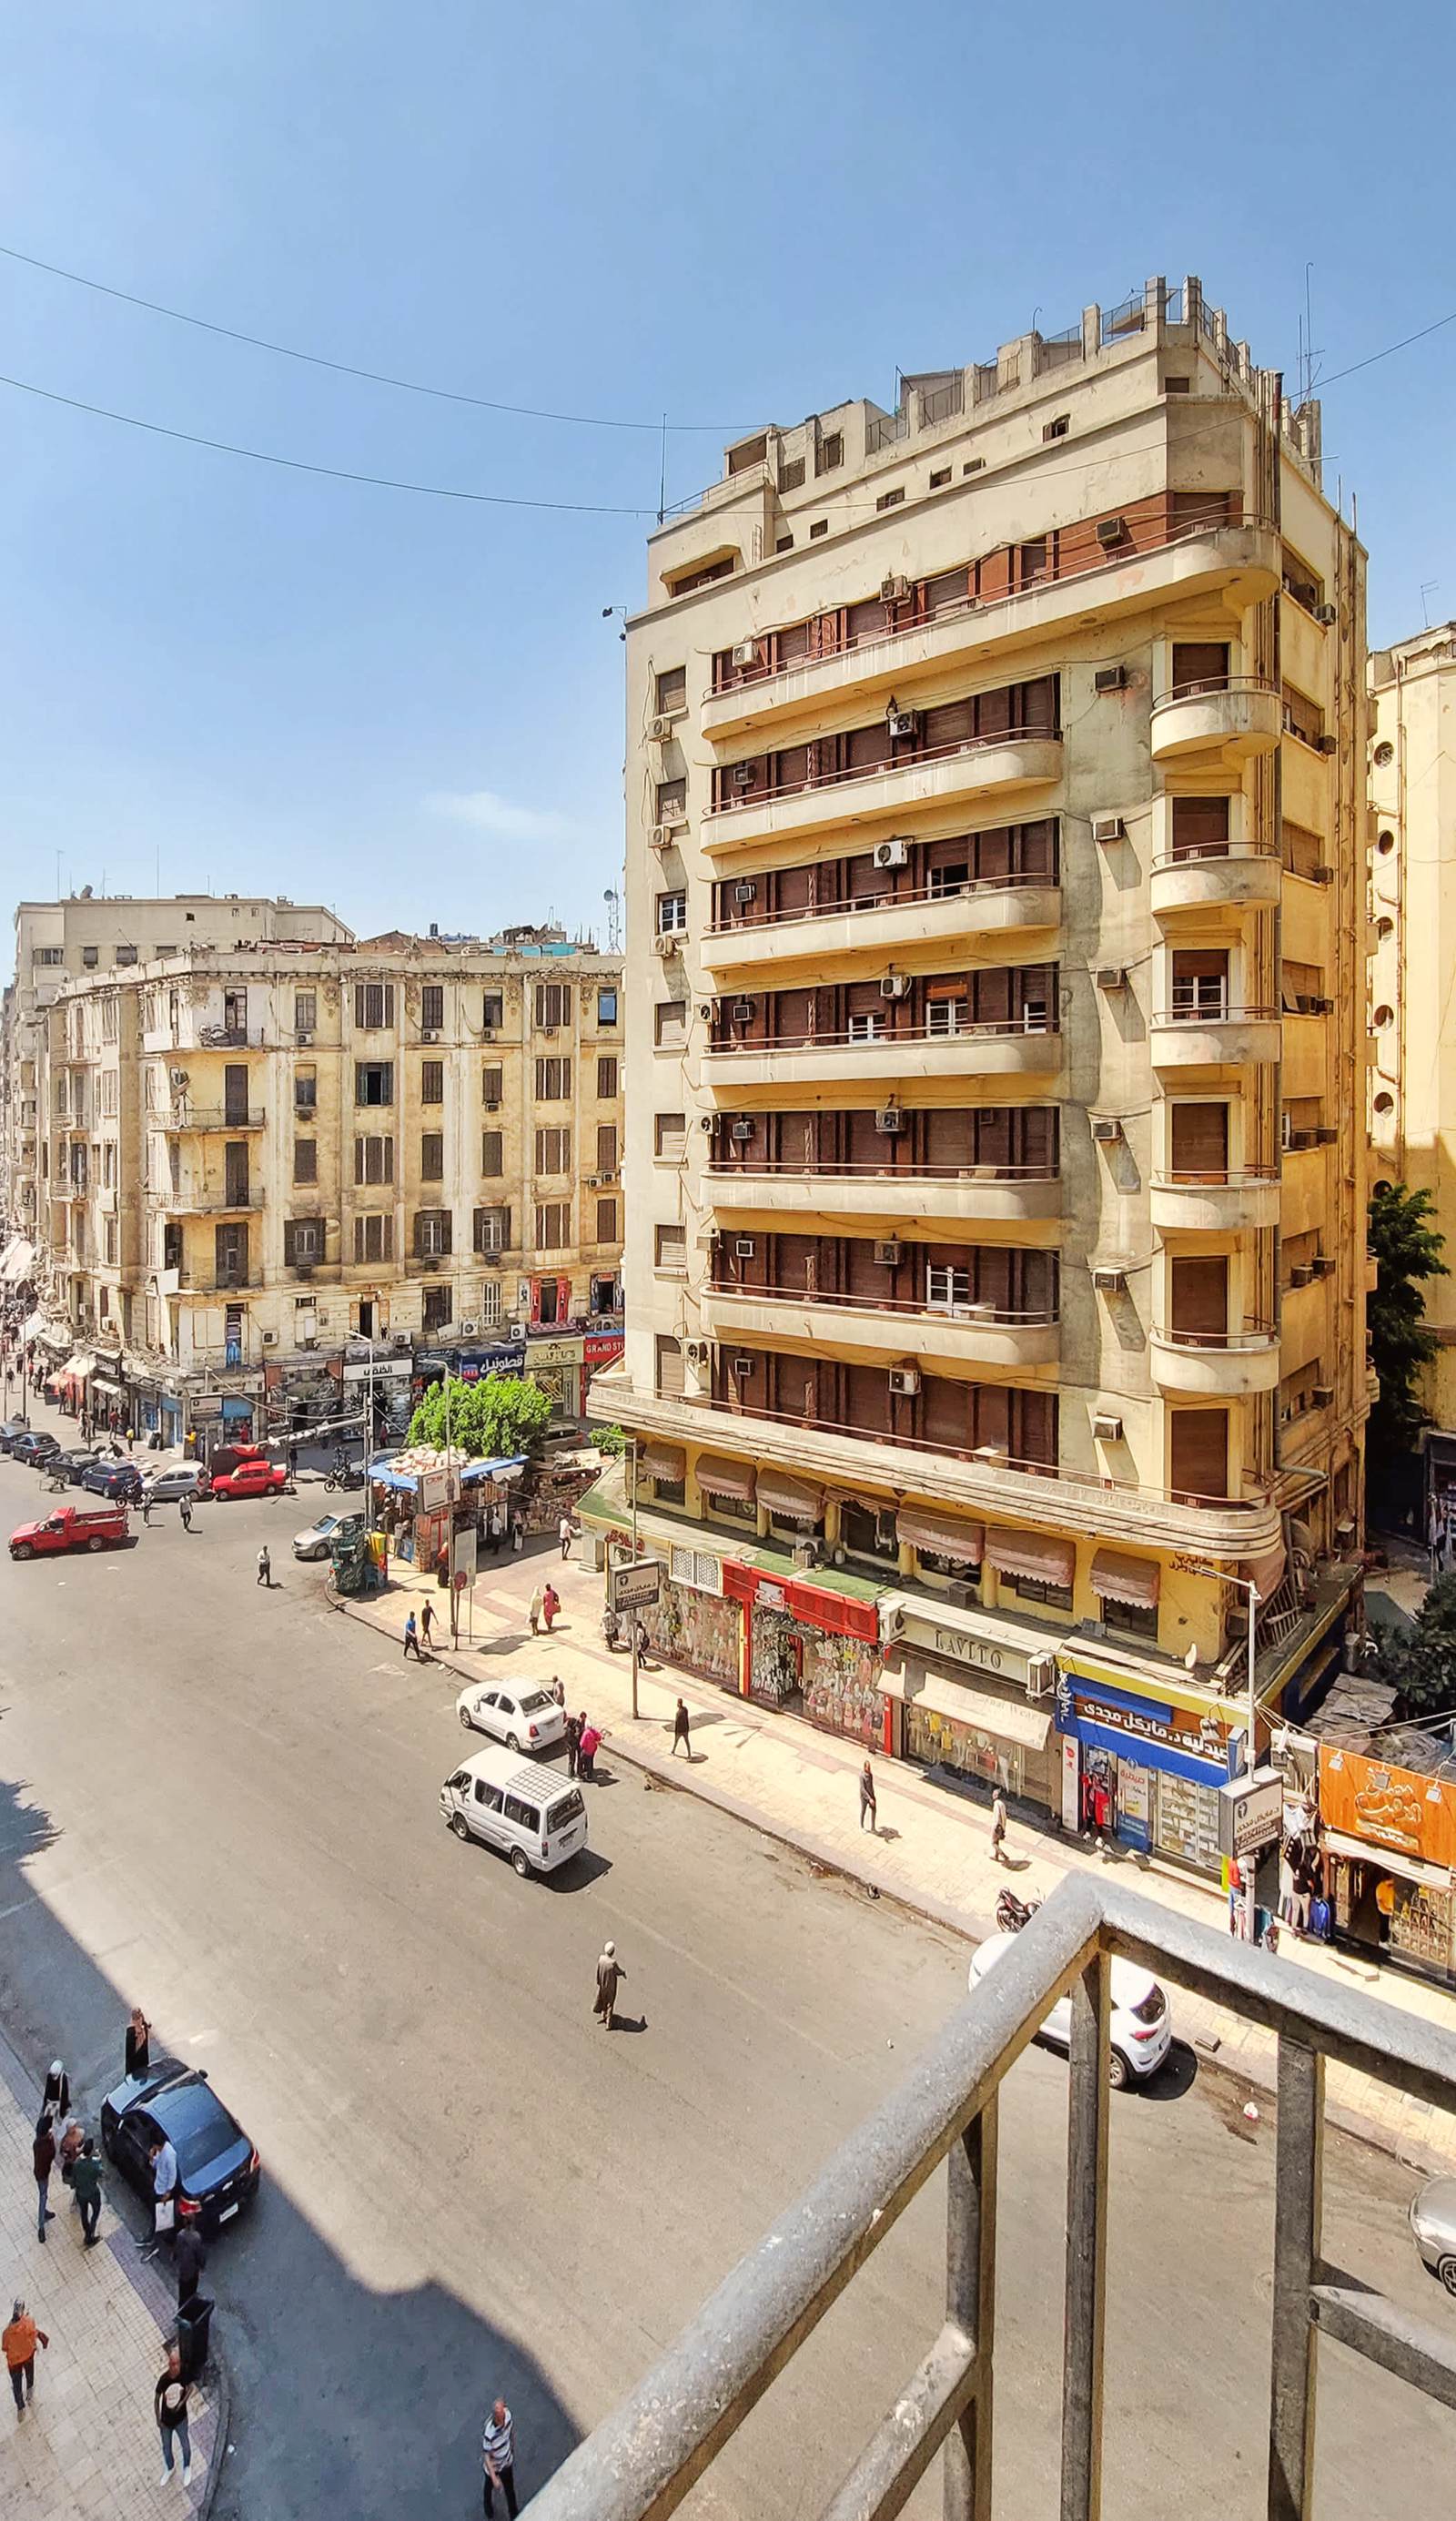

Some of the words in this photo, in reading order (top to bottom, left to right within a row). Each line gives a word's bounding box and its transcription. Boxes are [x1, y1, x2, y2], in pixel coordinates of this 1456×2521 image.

[586, 1341, 611, 1353] GRAND
[935, 1629, 1003, 1670] LAVITO
[1084, 1702, 1122, 1723] مجدى
[1123, 1712, 1168, 1739] مايكل
[1168, 1731, 1181, 1744] د.
